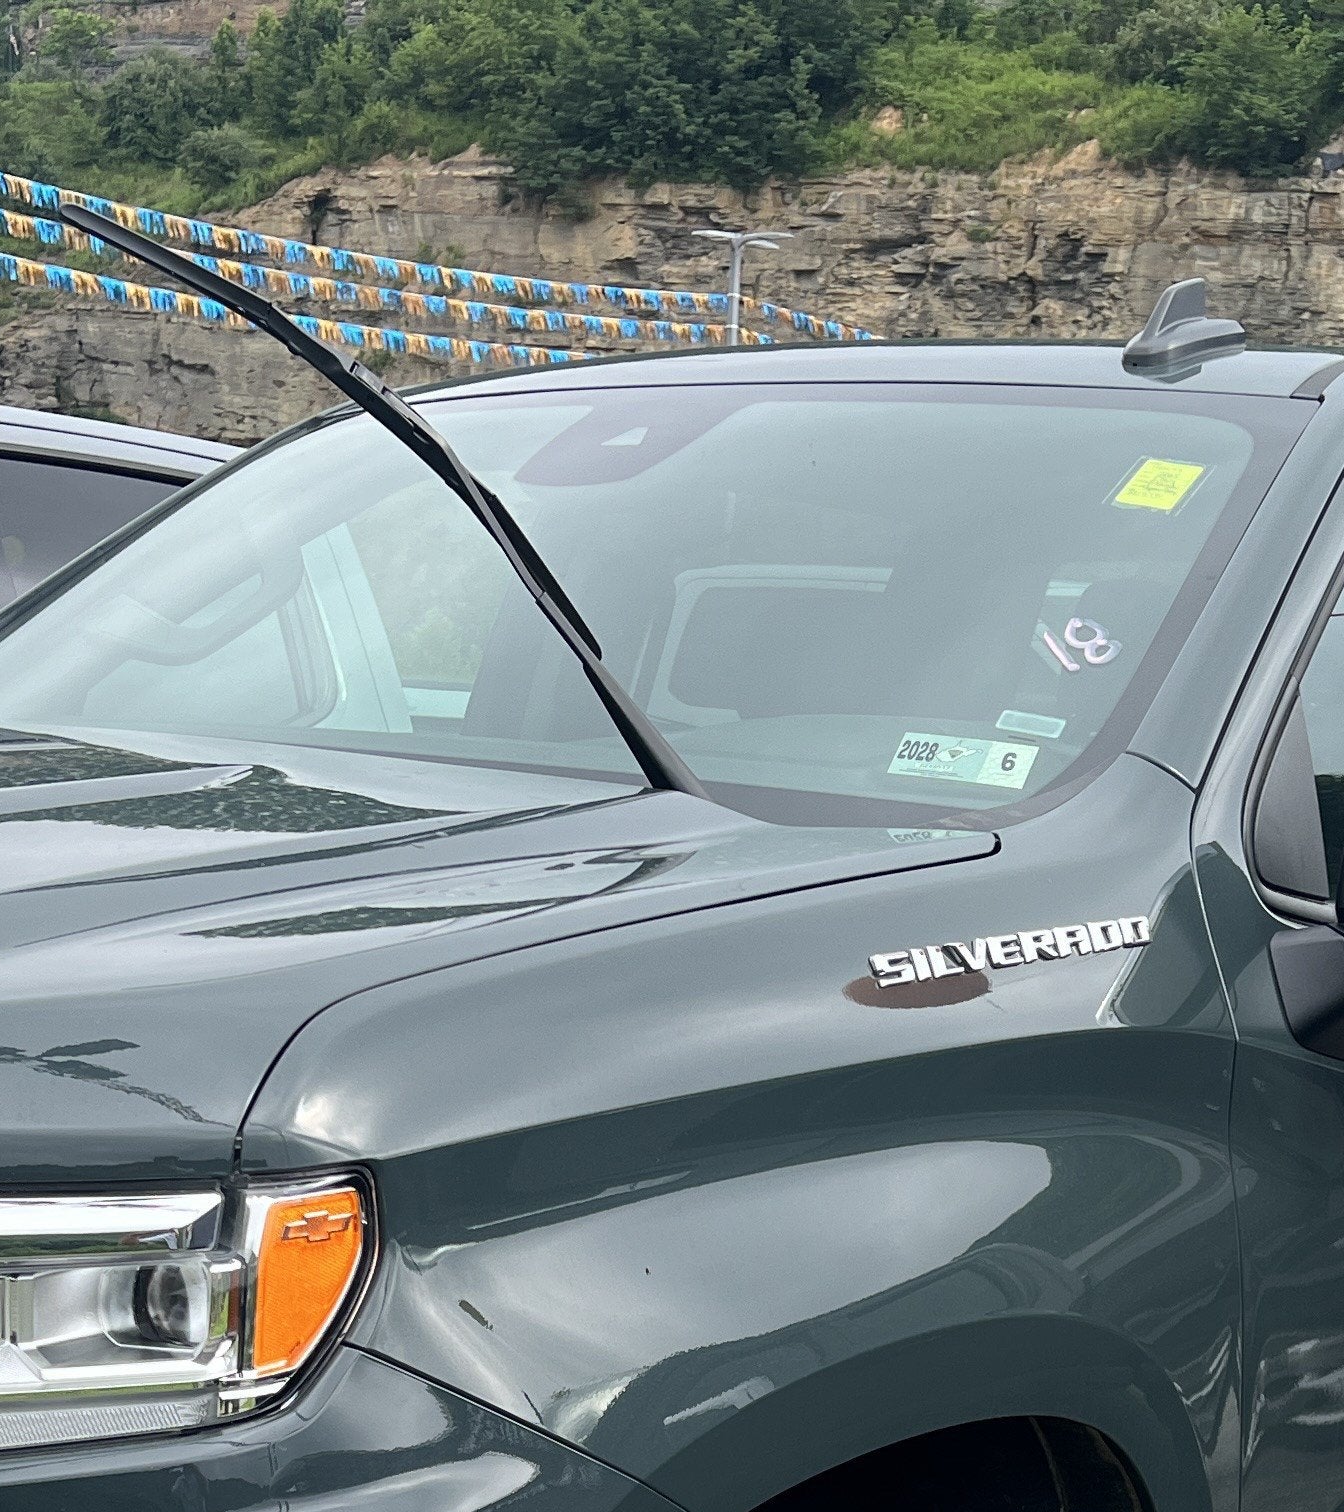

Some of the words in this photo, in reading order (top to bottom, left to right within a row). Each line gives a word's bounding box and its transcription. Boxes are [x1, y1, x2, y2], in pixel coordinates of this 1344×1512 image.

[1044, 617, 1122, 671] 18
[897, 740, 939, 762] 2028
[1001, 752, 1017, 771] 6
[868, 915, 1152, 988] SILVERADO
